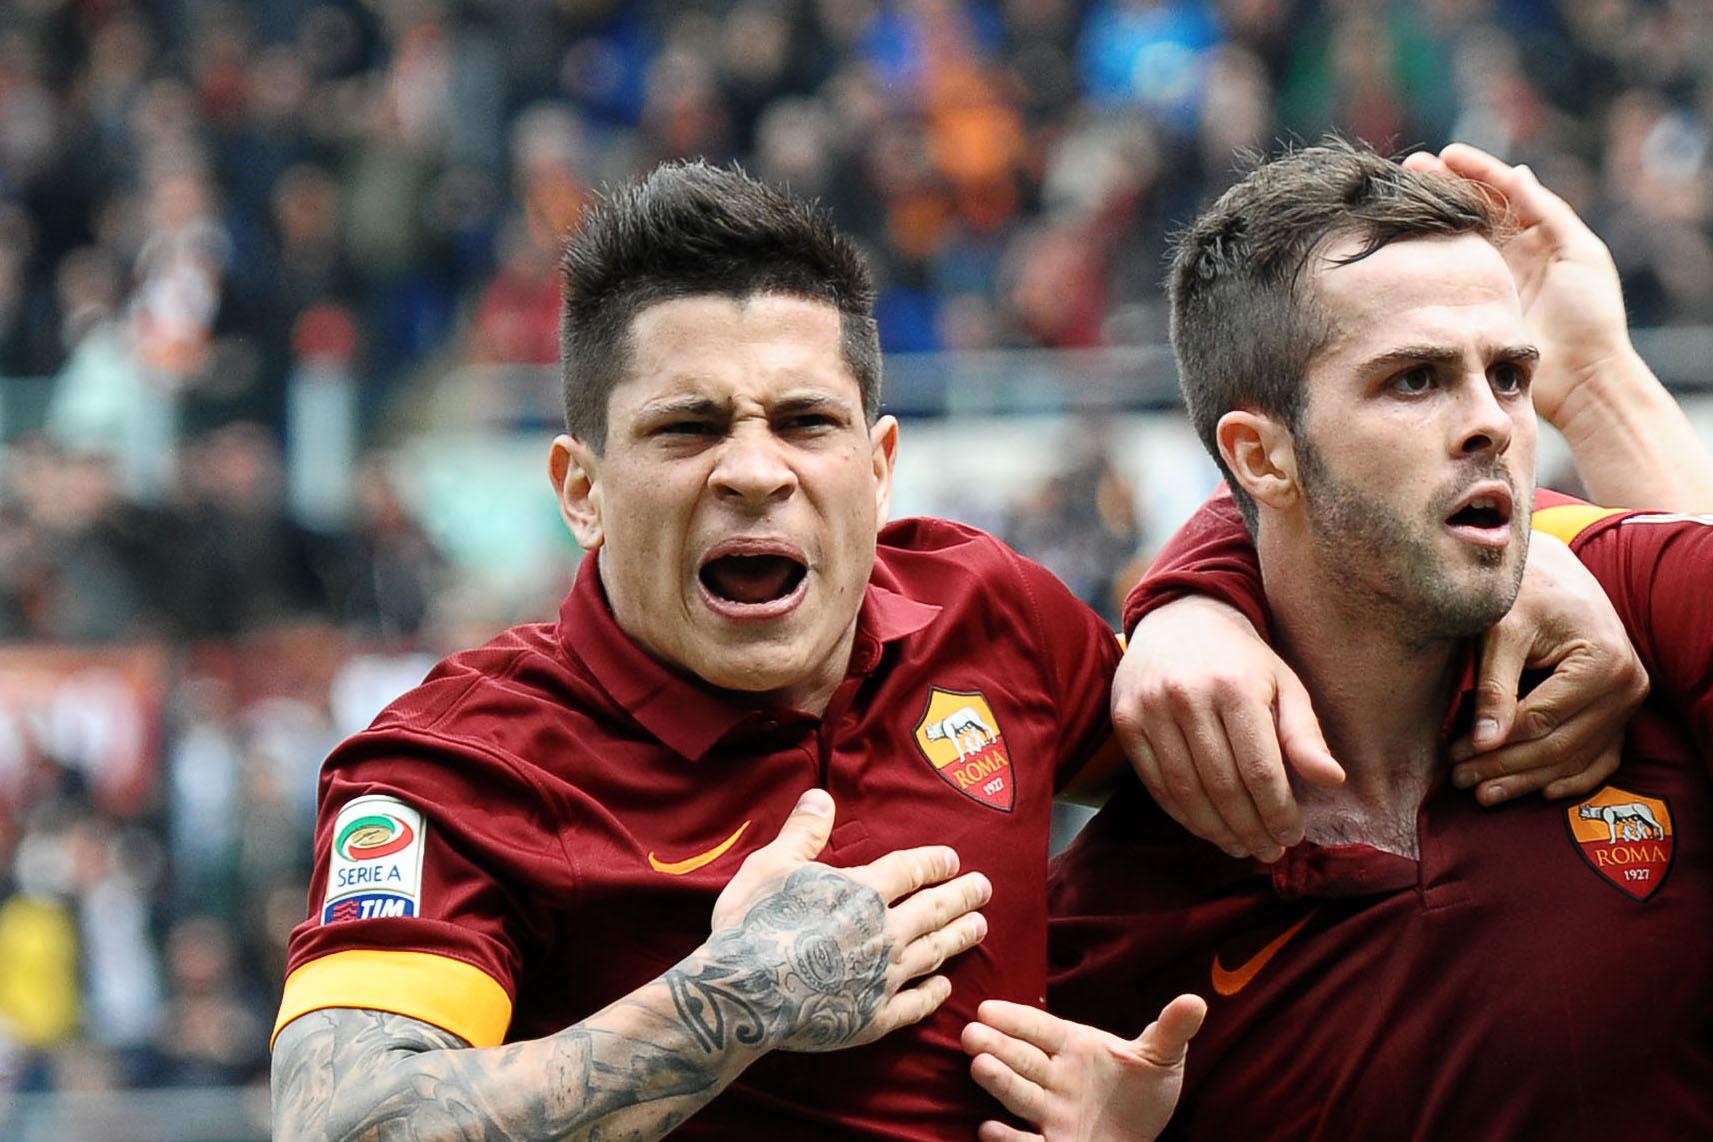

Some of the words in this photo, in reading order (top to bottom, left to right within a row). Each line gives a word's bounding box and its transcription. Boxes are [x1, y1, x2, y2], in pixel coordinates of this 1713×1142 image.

[953, 750, 1009, 790] ROMA
[1595, 846, 1666, 866] ROMA
[337, 865, 383, 887] SERIE
[387, 864, 401, 881] A
[1624, 869, 1650, 880] 1927
[360, 898, 406, 919] TIM
